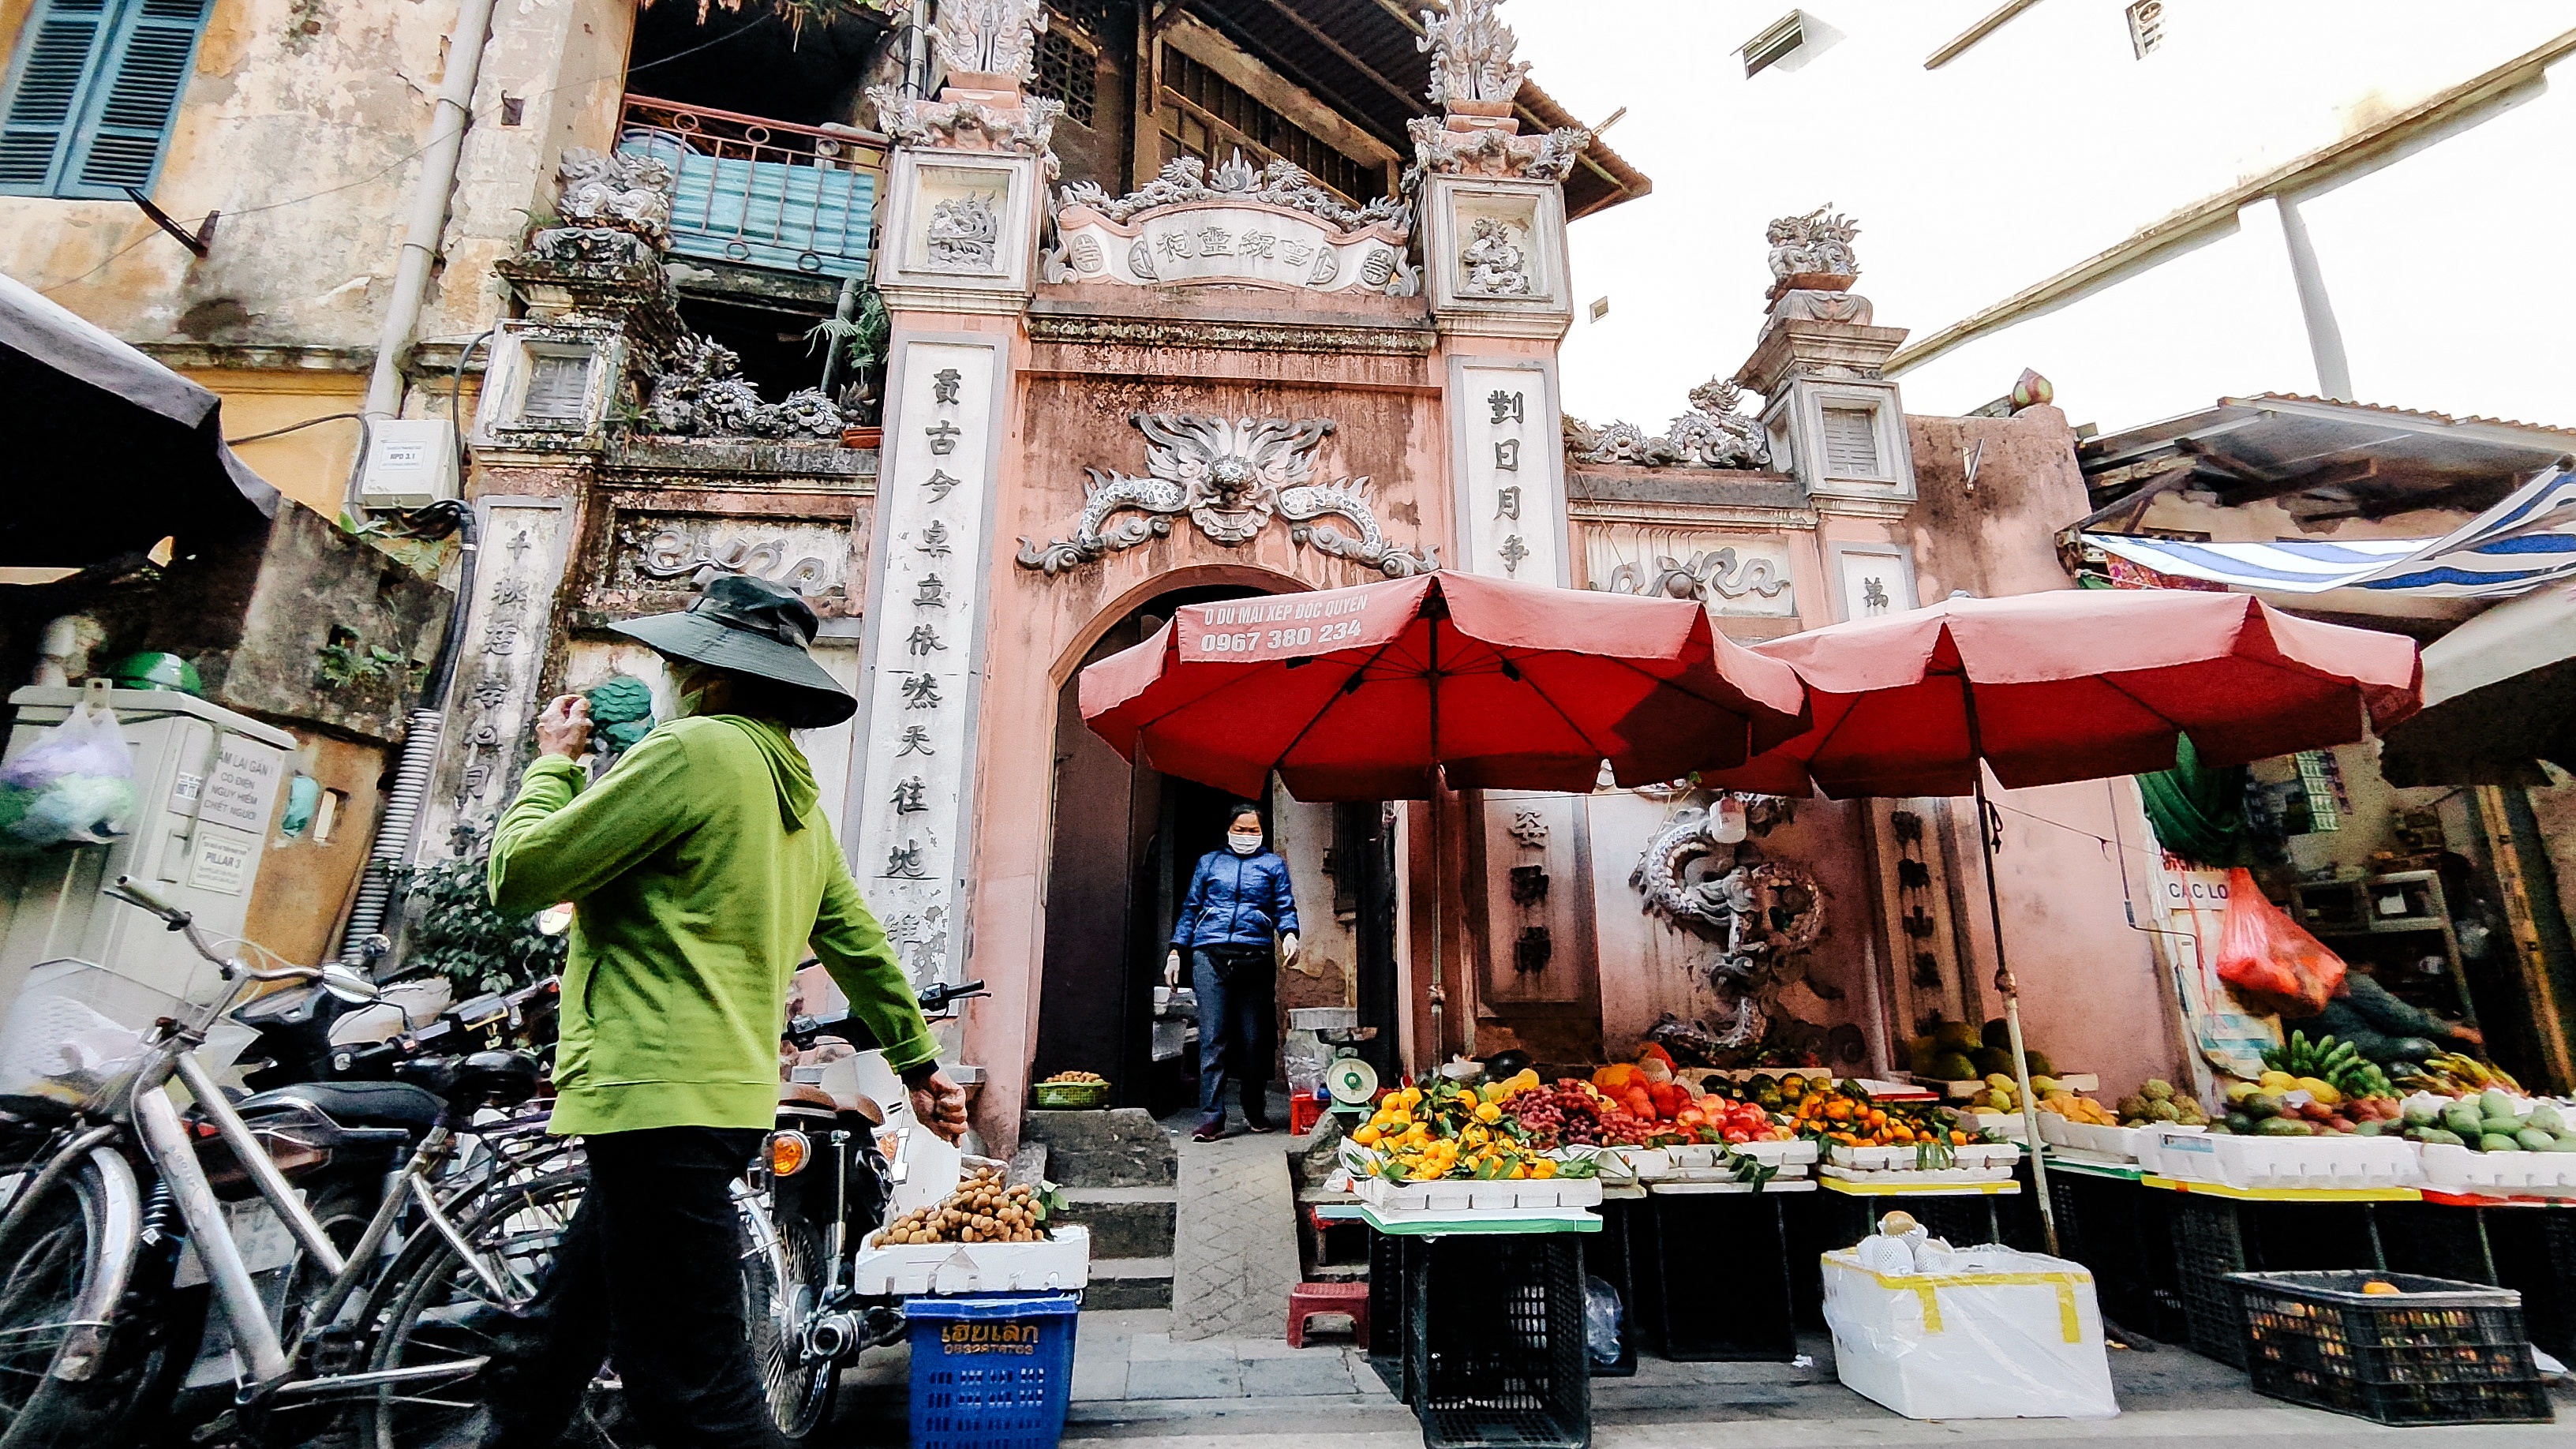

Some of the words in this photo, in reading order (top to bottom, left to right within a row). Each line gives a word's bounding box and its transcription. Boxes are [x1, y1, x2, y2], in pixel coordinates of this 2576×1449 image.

[1200, 631, 1261, 653] 0967
[1267, 625, 1312, 650] 380
[1317, 618, 1362, 643] 234
